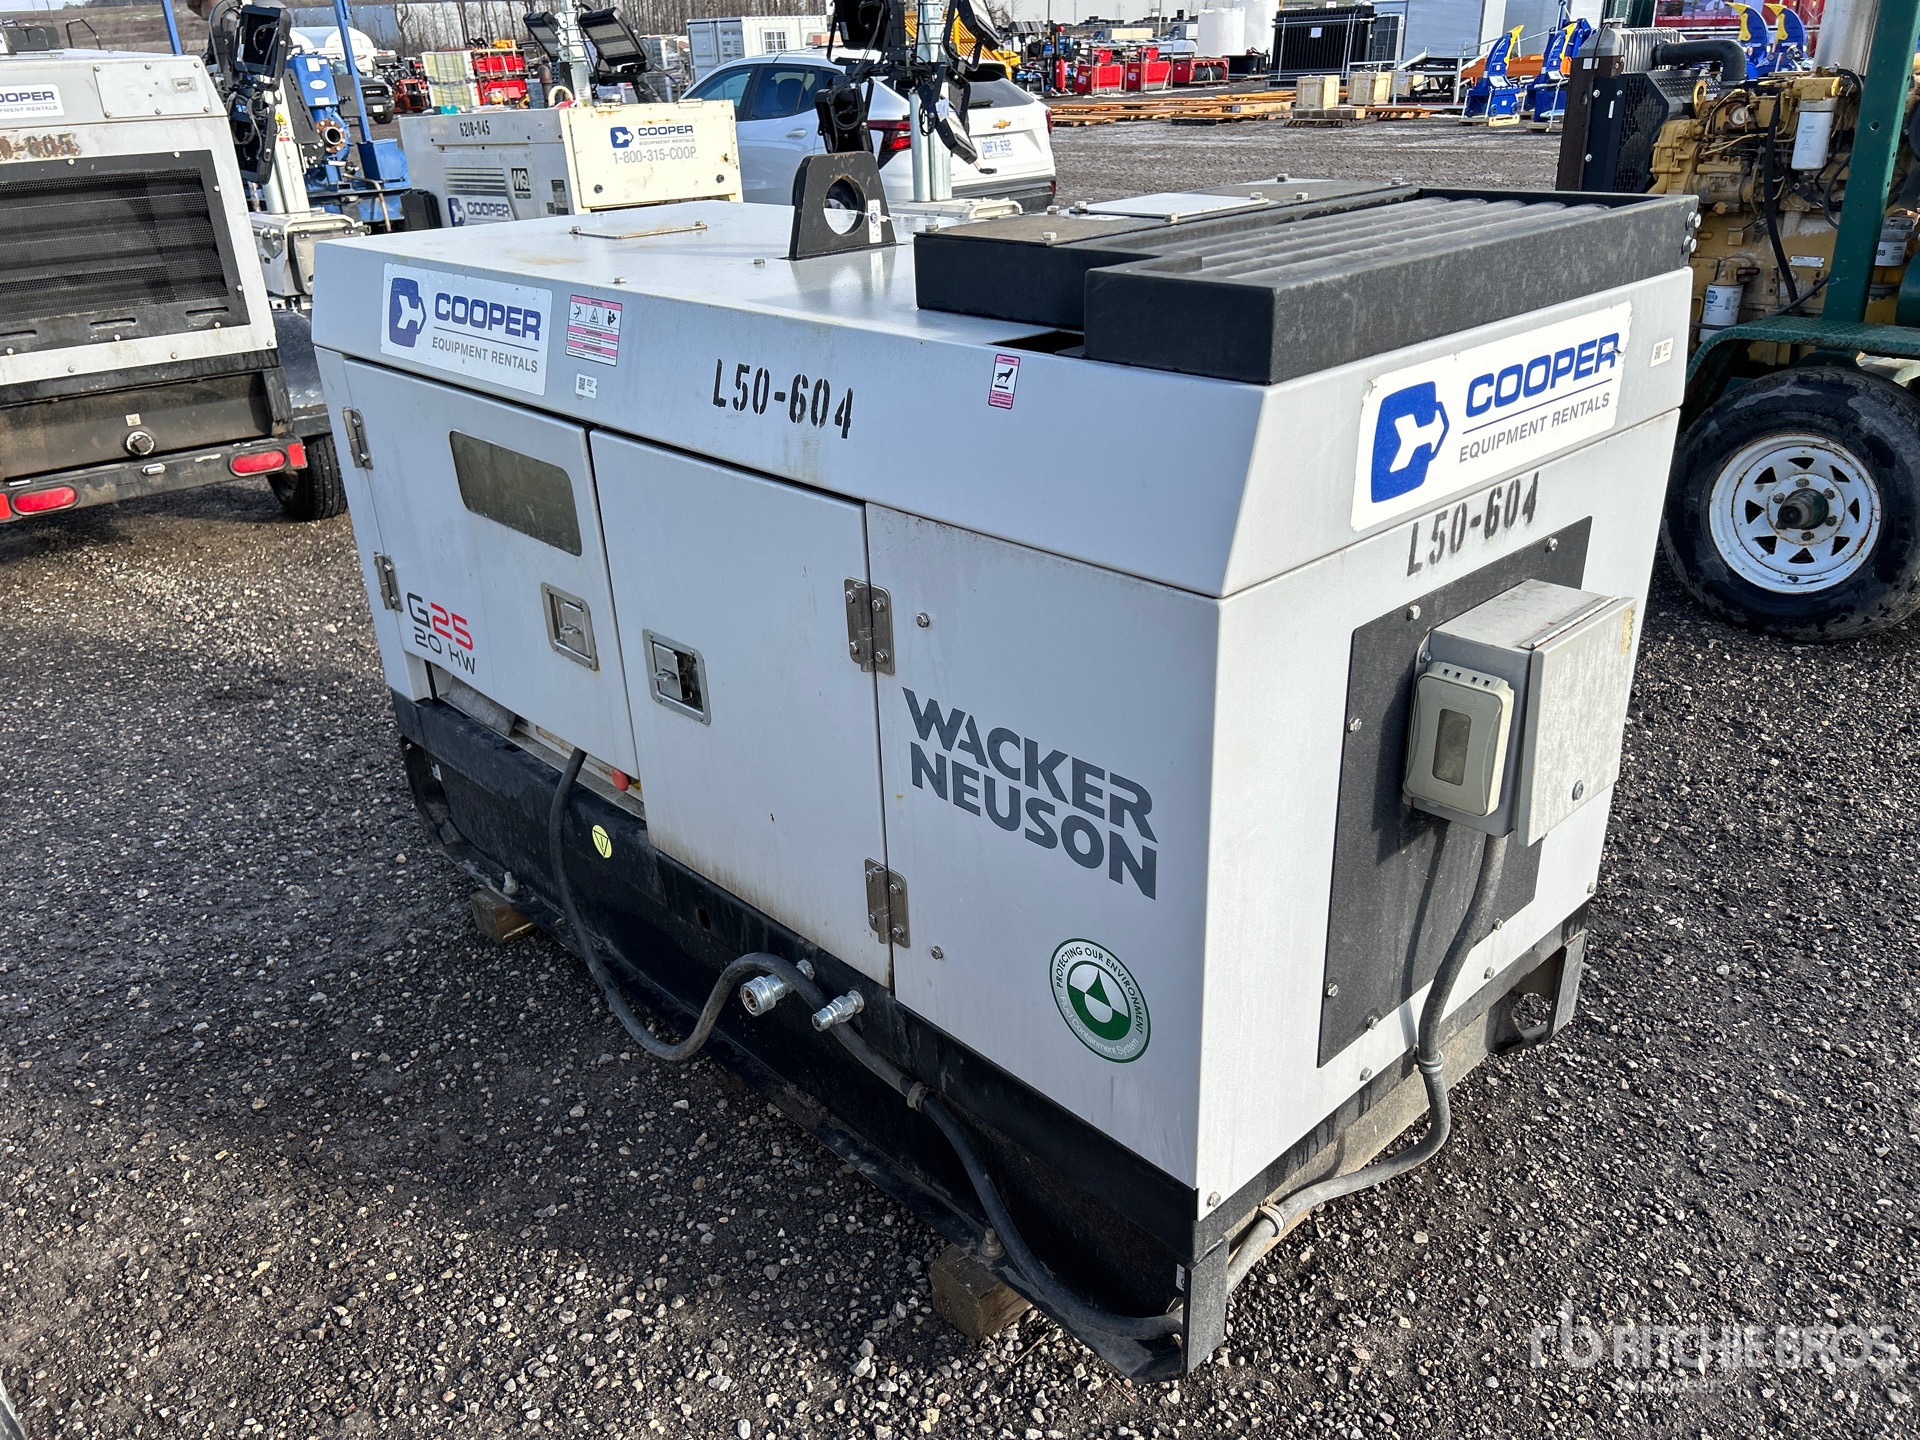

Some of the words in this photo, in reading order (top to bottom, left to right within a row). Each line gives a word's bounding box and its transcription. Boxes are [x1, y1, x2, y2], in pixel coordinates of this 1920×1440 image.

[638, 125, 694, 136] COOPER
[466, 201, 511, 218] COOPER
[435, 292, 541, 341] COOPER
[432, 336, 488, 361] EQUIPMENT
[491, 351, 538, 373] RENTALS
[1466, 332, 1620, 418] COOPER
[712, 358, 854, 440] L50-604
[1458, 416, 1547, 463] EQUIPMENT
[1551, 392, 1611, 428] RENTALS
[1406, 471, 1540, 577] L50-604
[407, 592, 474, 651] G25
[414, 626, 442, 654] 20
[902, 686, 1158, 844] WACKER
[910, 741, 1157, 901] NEUSON
[1055, 946, 1083, 989] PROTECTING
[1084, 947, 1104, 963] OUR
[1105, 957, 1144, 1035] ENVIRONMENT
[1060, 996, 1073, 1018] Fluid
[1072, 1018, 1117, 1055] Containment
[1116, 1038, 1140, 1056] System
